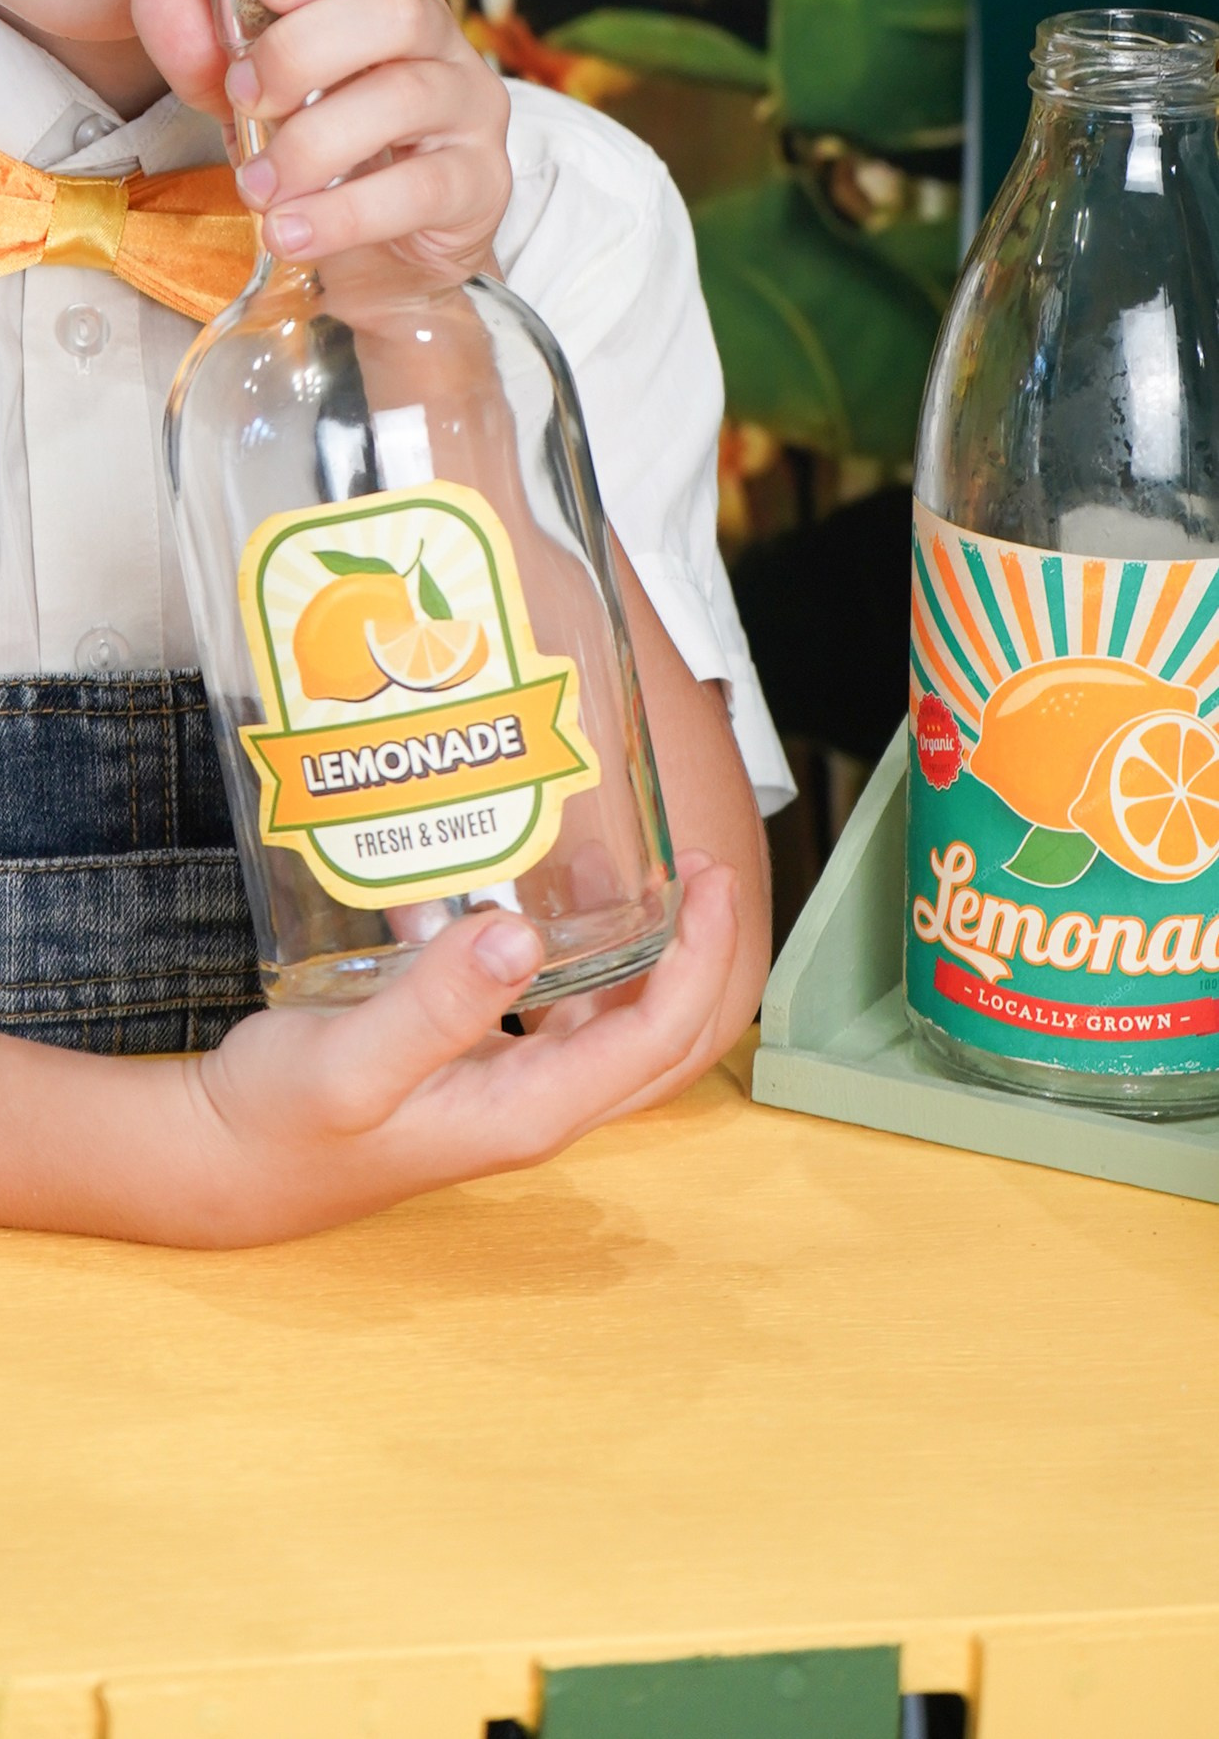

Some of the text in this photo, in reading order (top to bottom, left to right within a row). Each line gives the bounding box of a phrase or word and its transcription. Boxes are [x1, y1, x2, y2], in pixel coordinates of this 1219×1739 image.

[301, 714, 526, 797] LEMONADE
[919, 732, 955, 757] Organic
[354, 807, 499, 859] FRESH & SWEET
[977, 988, 1079, 1030] LOCALLY
[1086, 1012, 1173, 1033] GROWN
